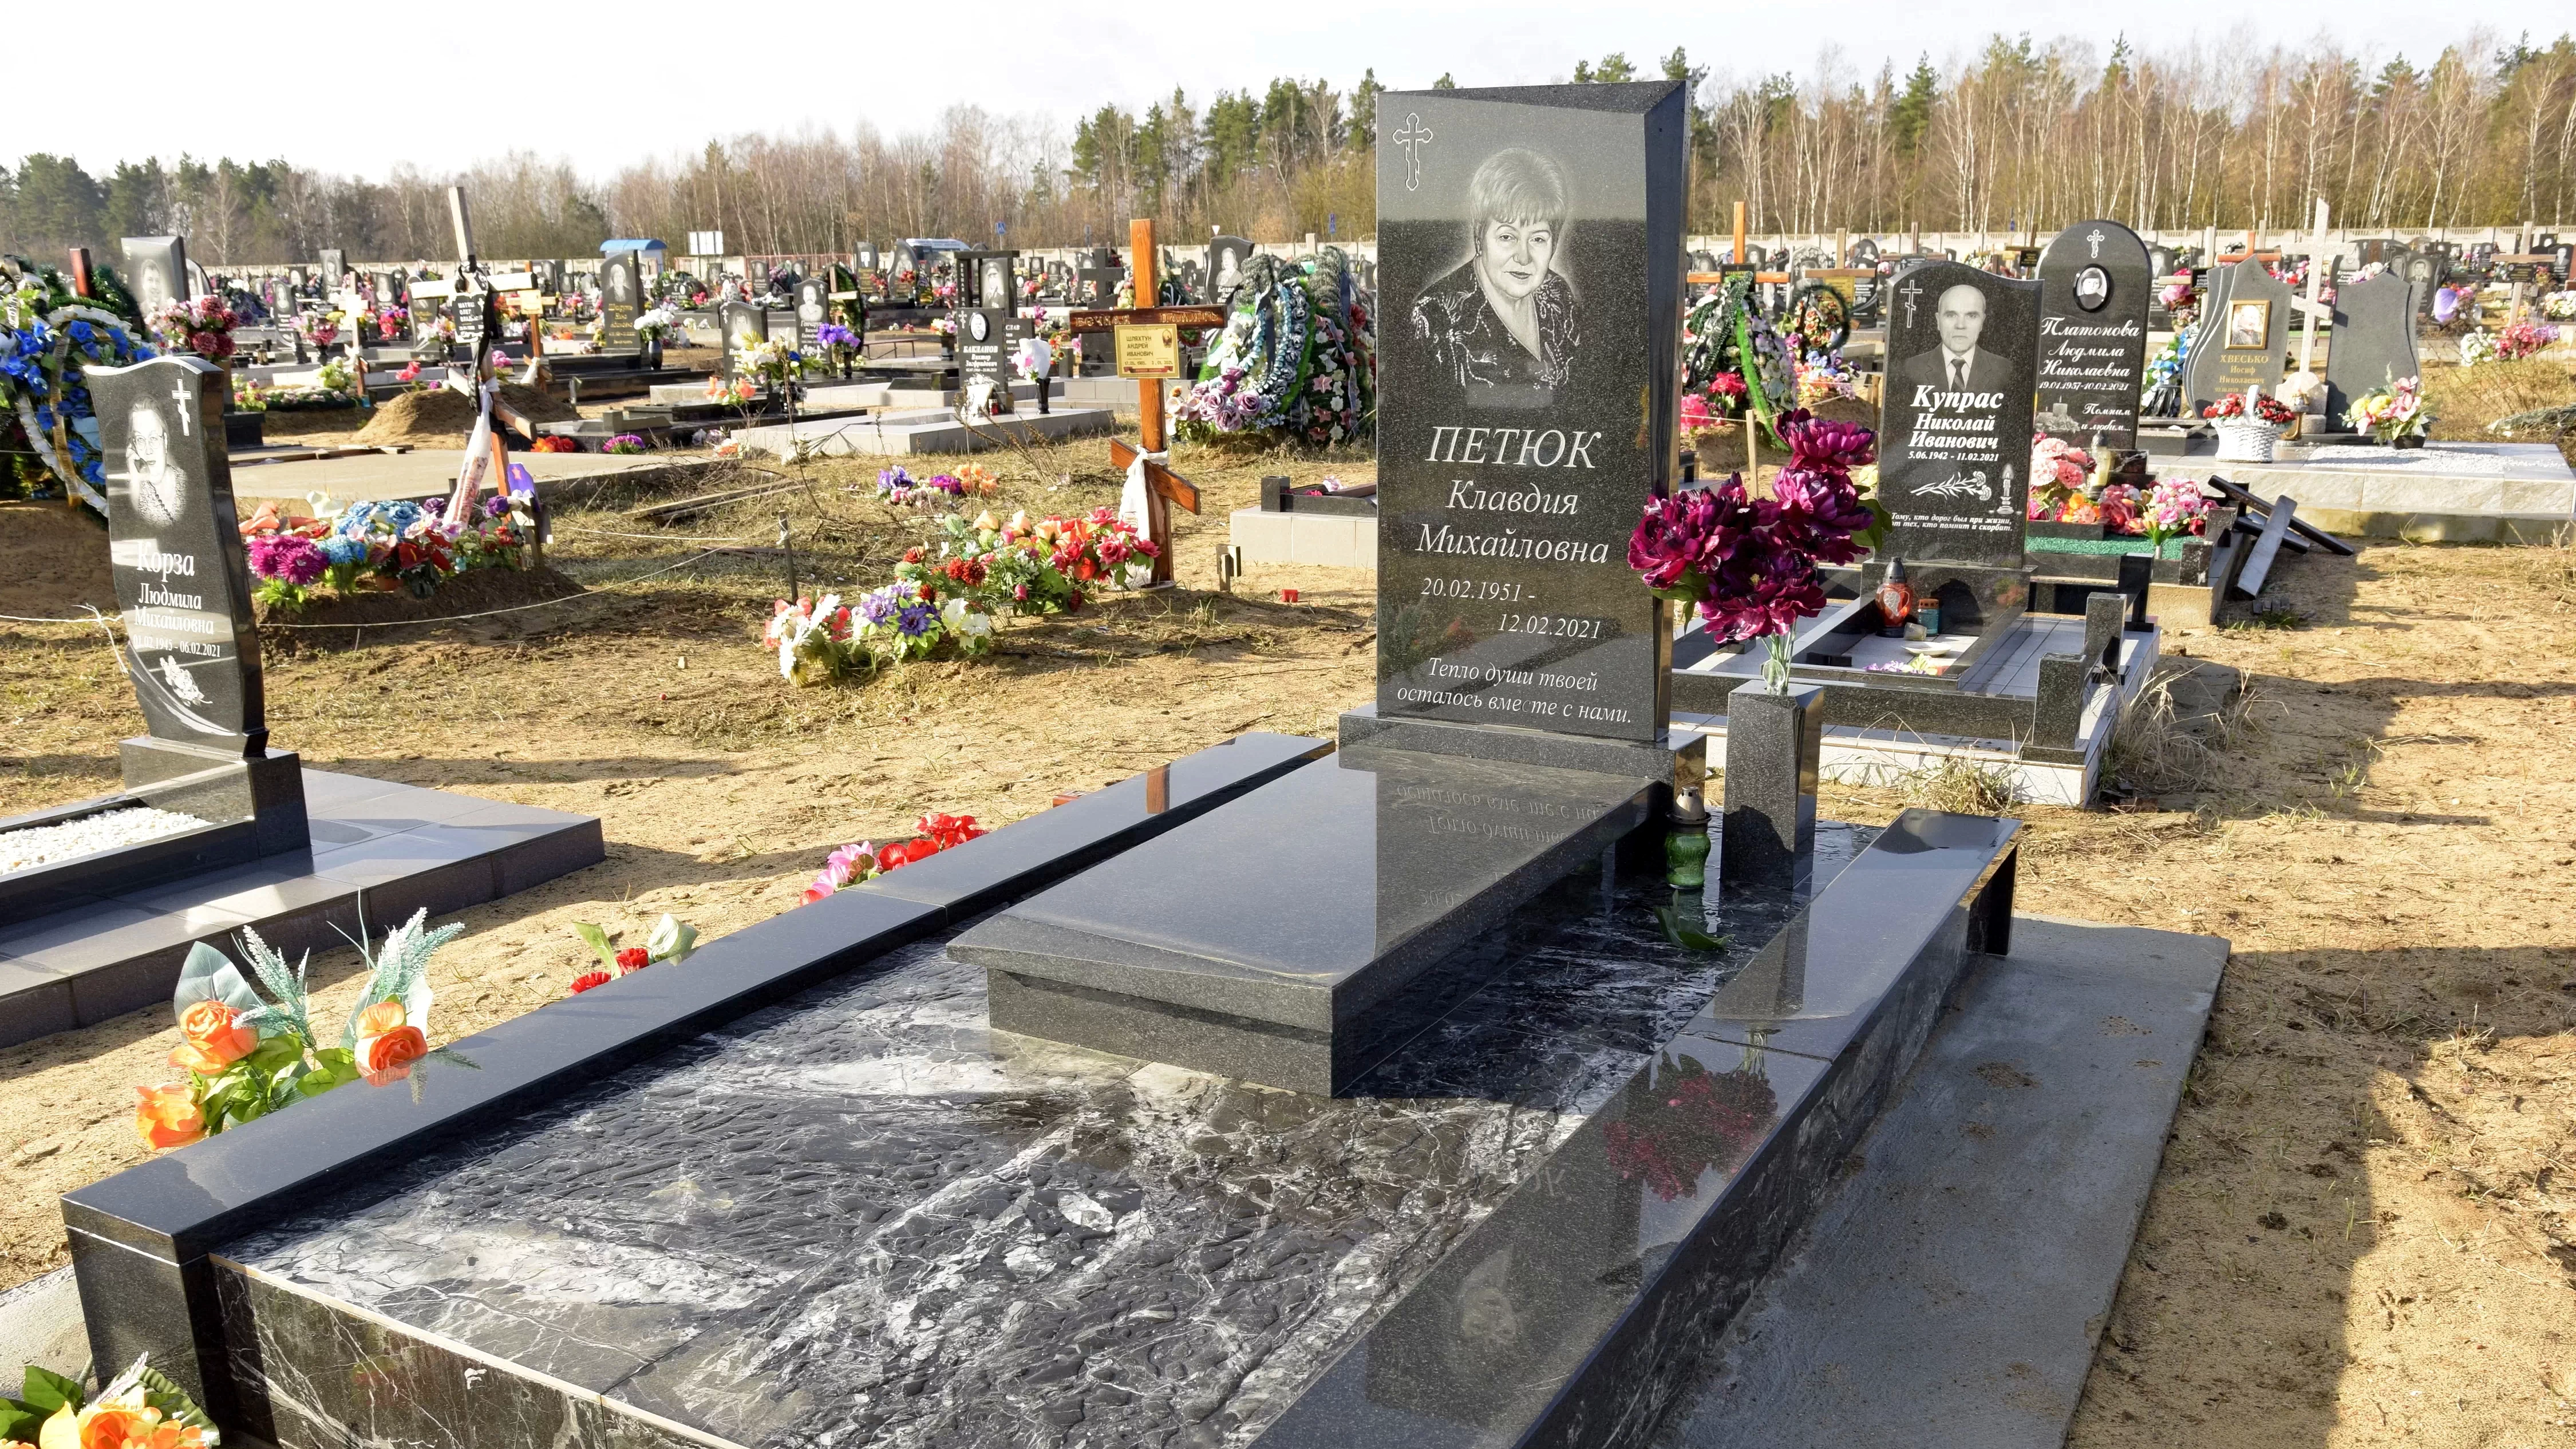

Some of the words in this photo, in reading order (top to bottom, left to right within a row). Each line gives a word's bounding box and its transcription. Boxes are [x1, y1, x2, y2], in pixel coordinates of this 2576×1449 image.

[2041, 317, 2140, 337] Платонова
[2048, 339, 2125, 362] Людмила
[2219, 354, 2269, 363] ХВЕСЬКО
[2040, 359, 2131, 377] Николаевна
[2230, 366, 2255, 376] Иосиф
[2219, 376, 2265, 384] Николаевич
[1910, 385, 2004, 413] Купрас
[2082, 403, 2131, 416] Помним
[1914, 413, 1996, 431] Николай
[1425, 426, 1602, 468] ПЕТЮК
[1908, 431, 1999, 449] Иванович
[1907, 451, 1949, 460] 5.06.1942
[1957, 452, 2000, 461] 11.02.2021
[1445, 480, 1578, 515] Клавдия
[1891, 512, 1912, 522] Тому,
[1931, 514, 1951, 523] дорог
[1985, 518, 2012, 526] жизни,
[1978, 523, 2013, 532] скорбит.
[1415, 523, 1609, 564] Михайловна
[136, 541, 195, 582] Корза
[139, 583, 202, 610] Людмила
[1421, 578, 1522, 602] 20.02.1951
[134, 605, 214, 634] Михайловна
[1498, 614, 1601, 639] 12.02.2021
[133, 634, 172, 651] 01.02.1945
[180, 641, 220, 657] 06.02.2021
[1428, 657, 1479, 680] Тепло
[1485, 662, 1533, 686] души
[1539, 671, 1598, 691] твоей
[1397, 687, 1482, 708] осталось
[1563, 704, 1571, 717] с
[1578, 706, 1631, 723] нами.
